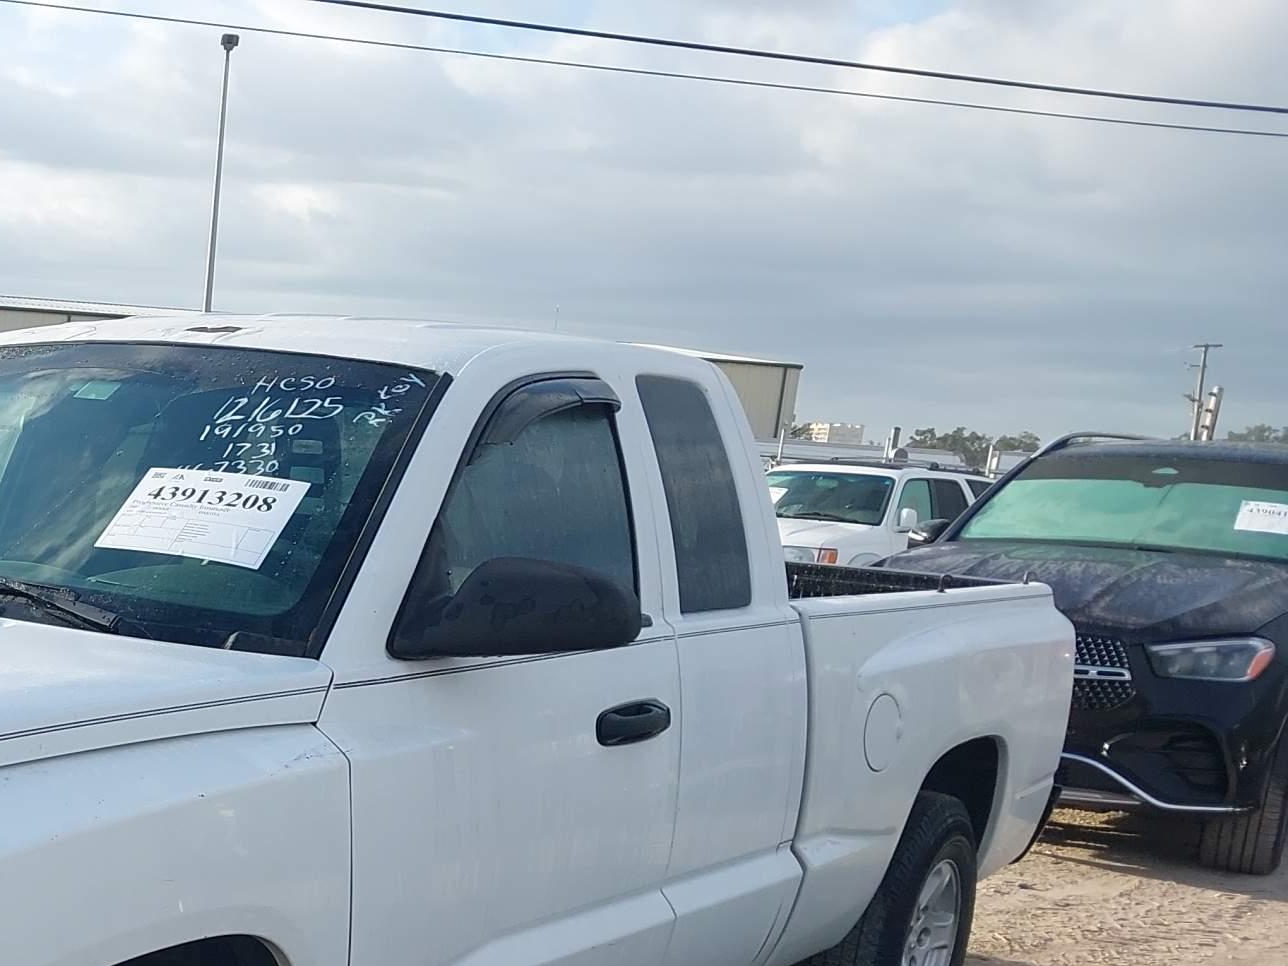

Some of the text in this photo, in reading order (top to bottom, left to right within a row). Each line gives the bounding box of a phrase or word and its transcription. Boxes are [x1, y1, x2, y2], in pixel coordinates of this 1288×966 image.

[251, 375, 336, 395] HCSO
[222, 442, 276, 459] 1731
[148, 485, 277, 512] 43913208
